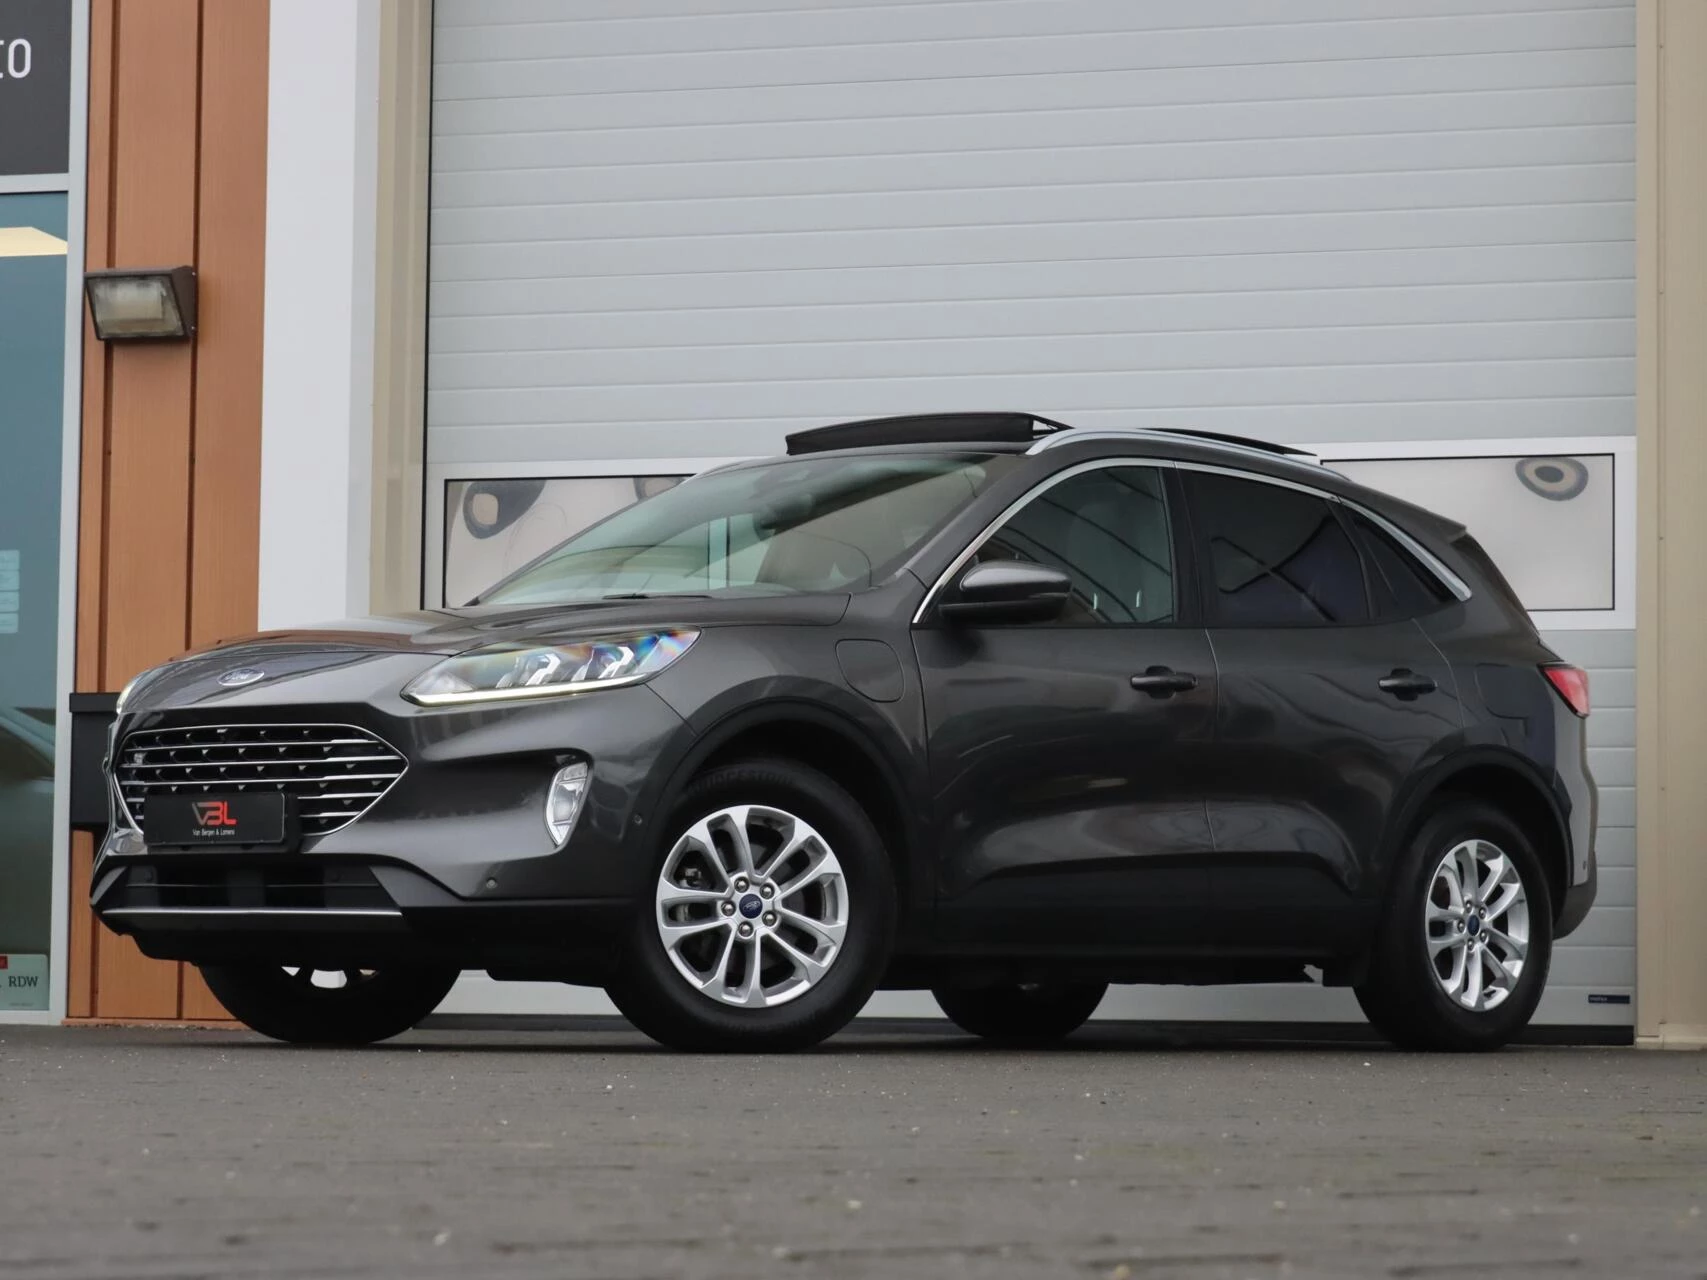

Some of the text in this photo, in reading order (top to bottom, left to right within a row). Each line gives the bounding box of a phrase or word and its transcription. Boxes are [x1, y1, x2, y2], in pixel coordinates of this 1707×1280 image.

[0, 38, 31, 79] O
[191, 800, 237, 826] VBL
[8, 975, 39, 988] RDW
